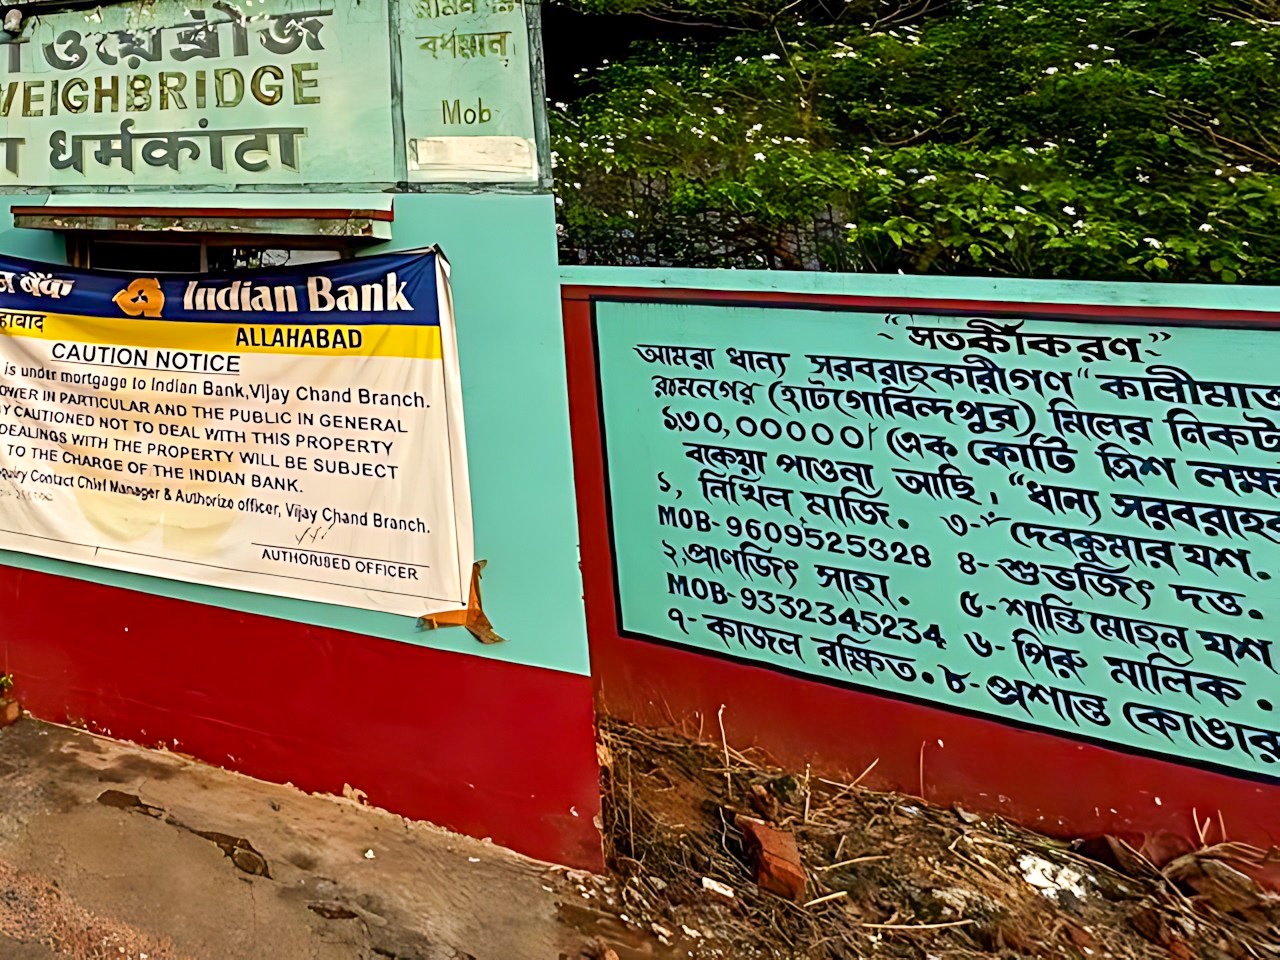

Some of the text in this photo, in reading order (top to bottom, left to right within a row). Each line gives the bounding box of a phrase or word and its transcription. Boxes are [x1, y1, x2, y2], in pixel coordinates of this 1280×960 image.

[441, 96, 492, 125] Mob
[183, 272, 415, 312] Indian Bank
[51, 342, 241, 374] CAUTION NOTICE
[235, 327, 363, 350] ALLAHABAD
[633, 343, 717, 371] আমরা
[725, 347, 791, 378] ধান্য
[4, 361, 16, 376] is
[132, 374, 146, 390] to
[151, 376, 197, 395] Indian
[296, 386, 352, 403] Chand
[358, 388, 431, 409] Branch.
[14, 405, 95, 427] CAUTIONED
[99, 416, 129, 432] NOT
[133, 420, 154, 435] TO
[159, 423, 201, 439] DEAL
[205, 427, 246, 443] WITH
[252, 431, 290, 447] THIS
[296, 434, 394, 456] PROPERTY
[43, 389, 56, 402] IN
[59, 393, 150, 414] PARTICULAR
[154, 404, 187, 417] AND
[192, 405, 224, 420] THE
[229, 408, 292, 425] PUBLIC
[297, 412, 314, 426] IN
[319, 414, 409, 433] GENERAL
[1047, 397, 1153, 445] মিলের
[7, 443, 304, 493] TO THE CHARGE OF THE INDIAN BANK.
[72, 433, 109, 449] WITH
[114, 438, 142, 454] THE
[147, 442, 234, 464] PROPERTY
[239, 451, 280, 468] WILL
[285, 456, 308, 471] BE
[313, 458, 399, 480] SUBJECT
[682, 442, 768, 475] বকেয়া
[776, 453, 875, 491] পাওনা
[967, 431, 1078, 474] কোটি
[30, 469, 74, 488] Contact
[109, 479, 160, 501] Manager
[164, 488, 173, 502] &
[285, 502, 318, 525] Vijay
[321, 506, 369, 527] Chand
[373, 512, 431, 534] Branch.
[698, 468, 795, 517] নিখিল
[261, 548, 419, 580] AUTHORISED OFFICER
[701, 613, 806, 664] কাজল
